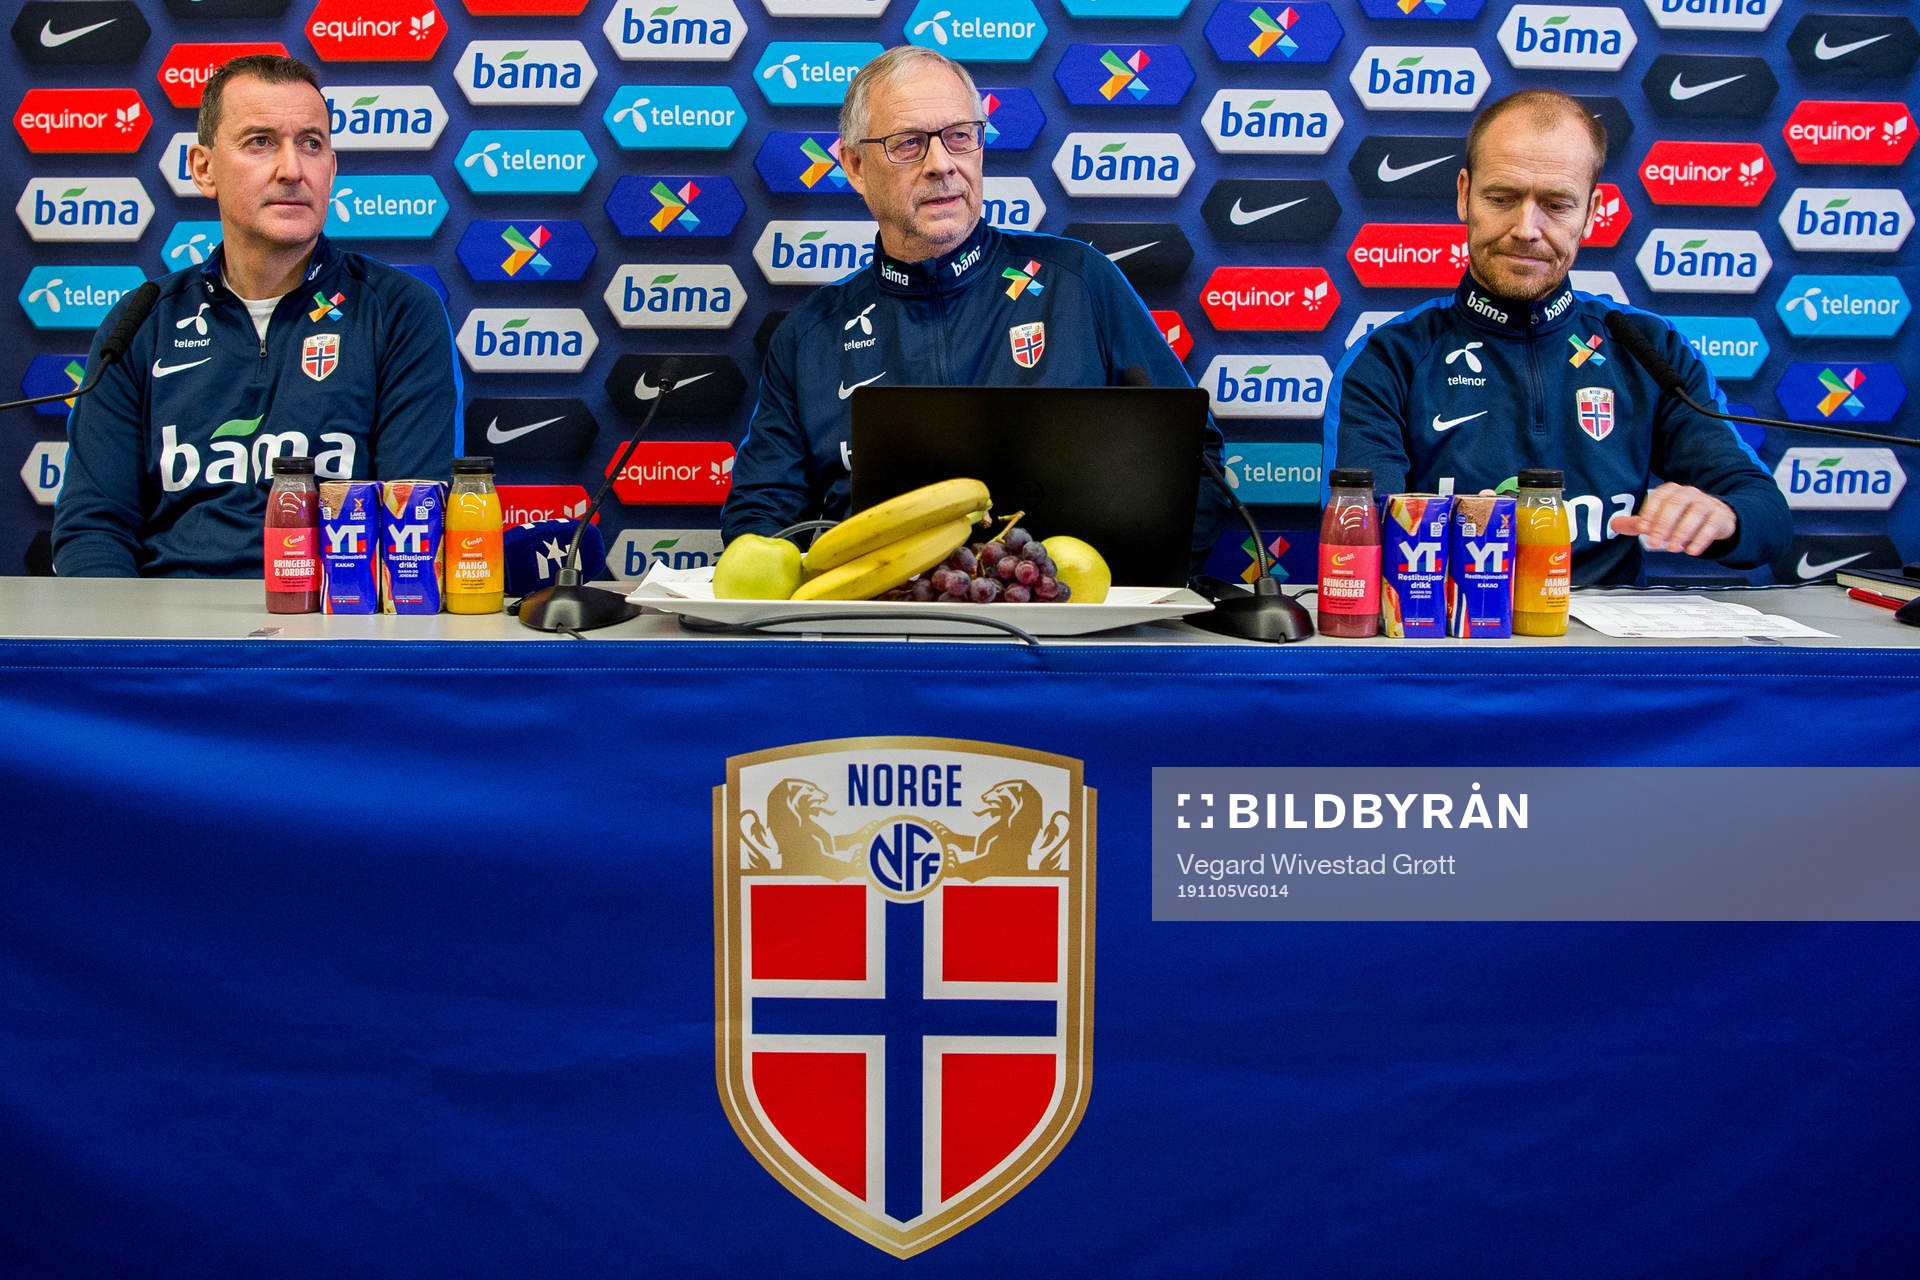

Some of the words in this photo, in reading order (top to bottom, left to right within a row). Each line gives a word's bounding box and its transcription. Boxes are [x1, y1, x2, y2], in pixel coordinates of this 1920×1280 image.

[312, 16, 402, 42] equinor
[622, 8, 732, 45] bama
[951, 17, 1036, 39] telenor
[1515, 16, 1622, 55] bama
[164, 63, 216, 89] equi
[472, 52, 582, 89] bama
[800, 61, 860, 83] telen
[1368, 58, 1476, 95] bama
[20, 107, 108, 134] equinor
[326, 98, 433, 135] bama
[650, 105, 735, 127] telenor
[1220, 100, 1328, 138] bama
[1789, 120, 1876, 146] equinor
[501, 149, 586, 170] telenor
[1070, 144, 1180, 182] bama
[1645, 161, 1732, 185] equinor
[35, 189, 139, 226] bama
[353, 189, 437, 216] telenor
[983, 199, 1030, 226] ma
[1796, 200, 1900, 237] bama
[951, 245, 981, 277] bam
[1353, 243, 1443, 268] equinor
[1653, 240, 1757, 278] bama
[63, 284, 129, 306] telen
[623, 275, 731, 313] bama
[1206, 286, 1295, 312] equinor
[1467, 290, 1509, 325] bama
[1544, 290, 1573, 322] bama
[1821, 294, 1901, 317] telenor
[174, 337, 211, 348] telenor
[474, 319, 583, 357] bama
[844, 336, 876, 351] telenor
[1216, 366, 1324, 403] bama
[1447, 374, 1487, 387] telenor
[1789, 459, 1892, 495] bama
[325, 524, 366, 553] YT
[388, 524, 429, 553] YT
[398, 561, 418, 569] drikk
[458, 561, 488, 570] MANGO
[1399, 541, 1442, 572] YT
[1465, 541, 1508, 572] YT
[1410, 581, 1432, 589] drikk
[847, 763, 962, 808] NORGE
